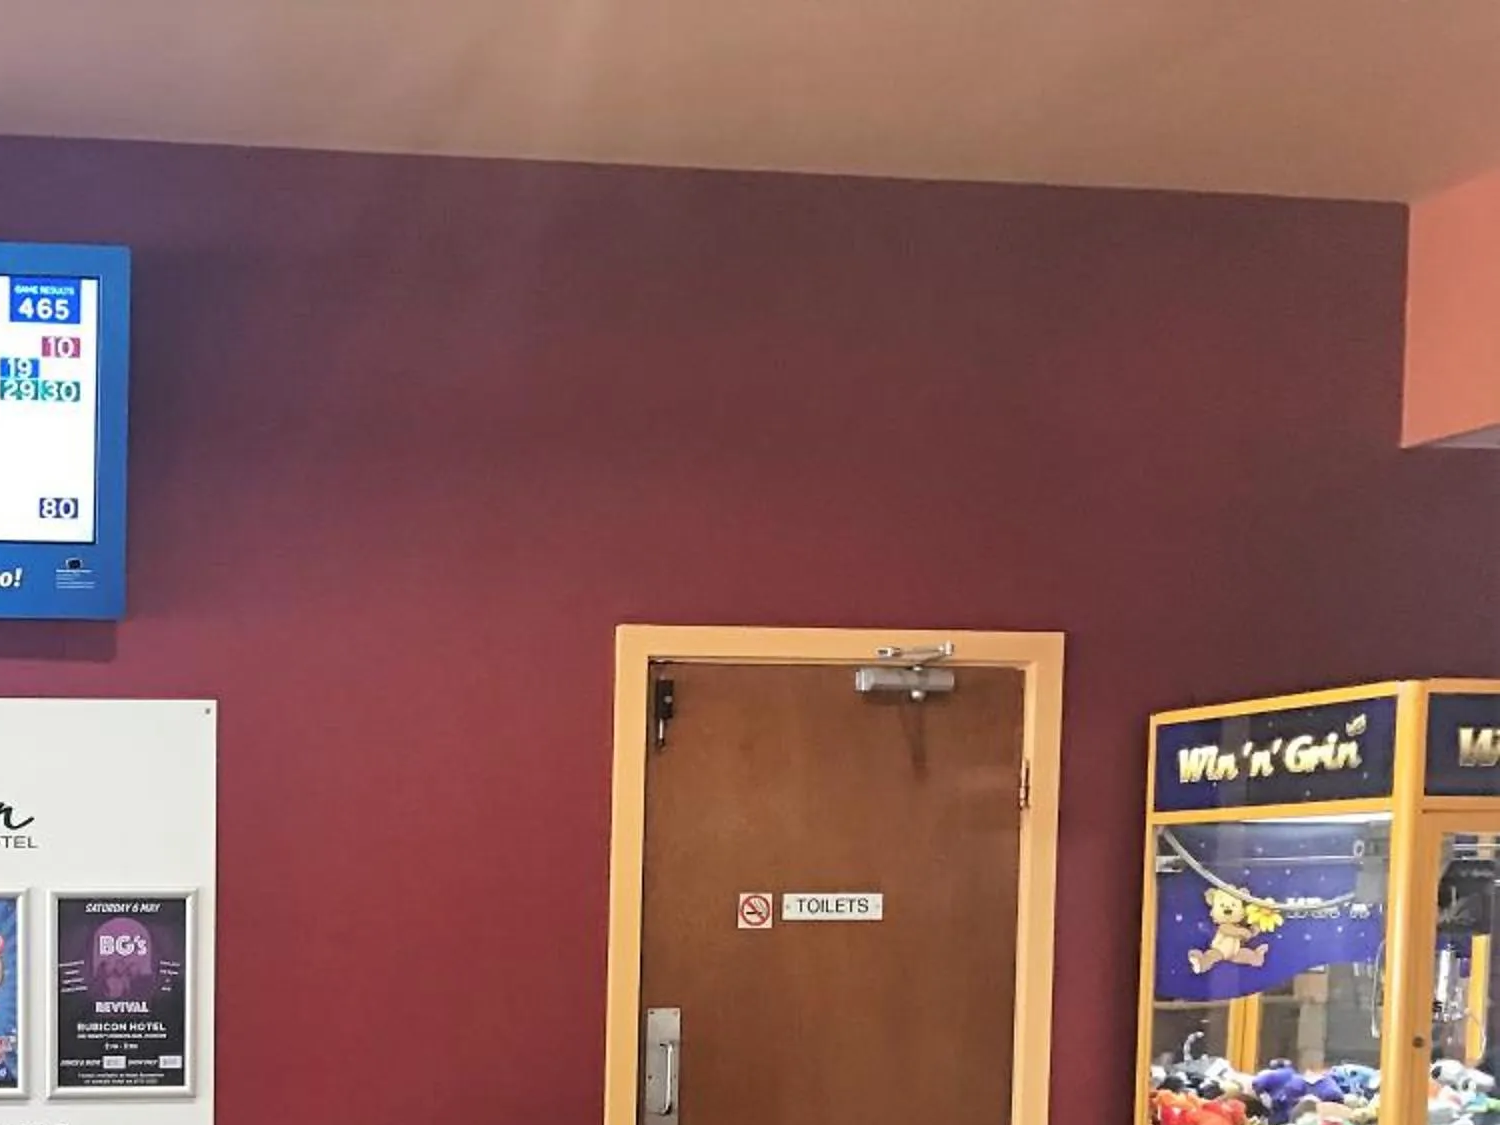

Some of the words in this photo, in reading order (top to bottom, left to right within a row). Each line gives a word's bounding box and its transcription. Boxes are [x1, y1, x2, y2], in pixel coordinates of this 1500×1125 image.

[18, 299, 70, 320] 465
[47, 337, 75, 357] 10
[8, 359, 33, 379] 19
[4, 380, 36, 400] 29
[45, 382, 77, 401] 30
[41, 499, 75, 519] 80
[1178, 744, 1239, 784] Win
[1284, 732, 1363, 774] Grin
[85, 903, 132, 913] SATURDAY
[140, 903, 161, 913] MAY
[796, 897, 870, 914] TOILETS
[99, 935, 148, 956] BG's
[96, 1001, 149, 1013] REVIVAL
[77, 1023, 127, 1032] RUBICON
[129, 1022, 167, 1031] HOTEL
